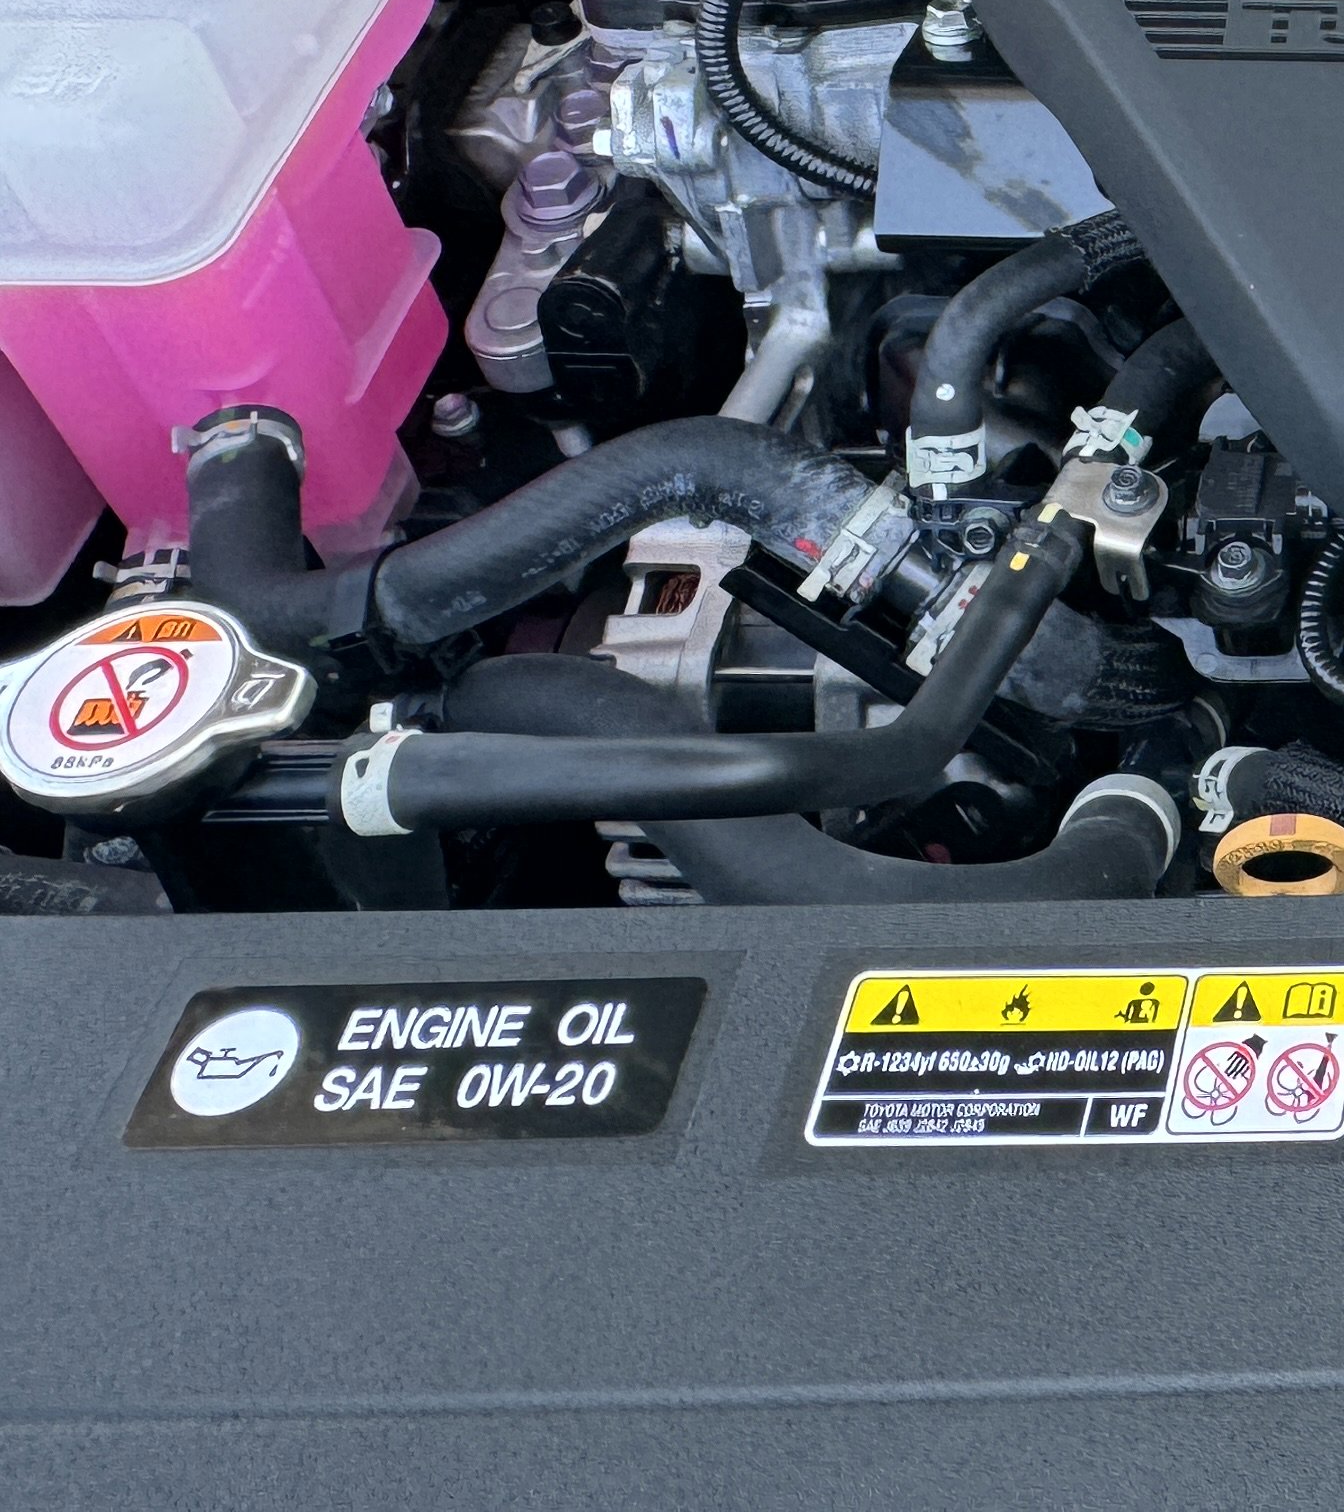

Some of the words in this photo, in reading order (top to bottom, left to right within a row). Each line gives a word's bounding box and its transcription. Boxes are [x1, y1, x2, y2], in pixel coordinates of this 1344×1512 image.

[337, 1003, 532, 1052] ENGINE
[556, 1002, 636, 1047] OIL
[312, 1065, 428, 1113] SAE
[456, 1060, 617, 1109] 0W-20
[863, 1103, 909, 1118] TOYOTA
[1110, 1103, 1149, 1129] WF
